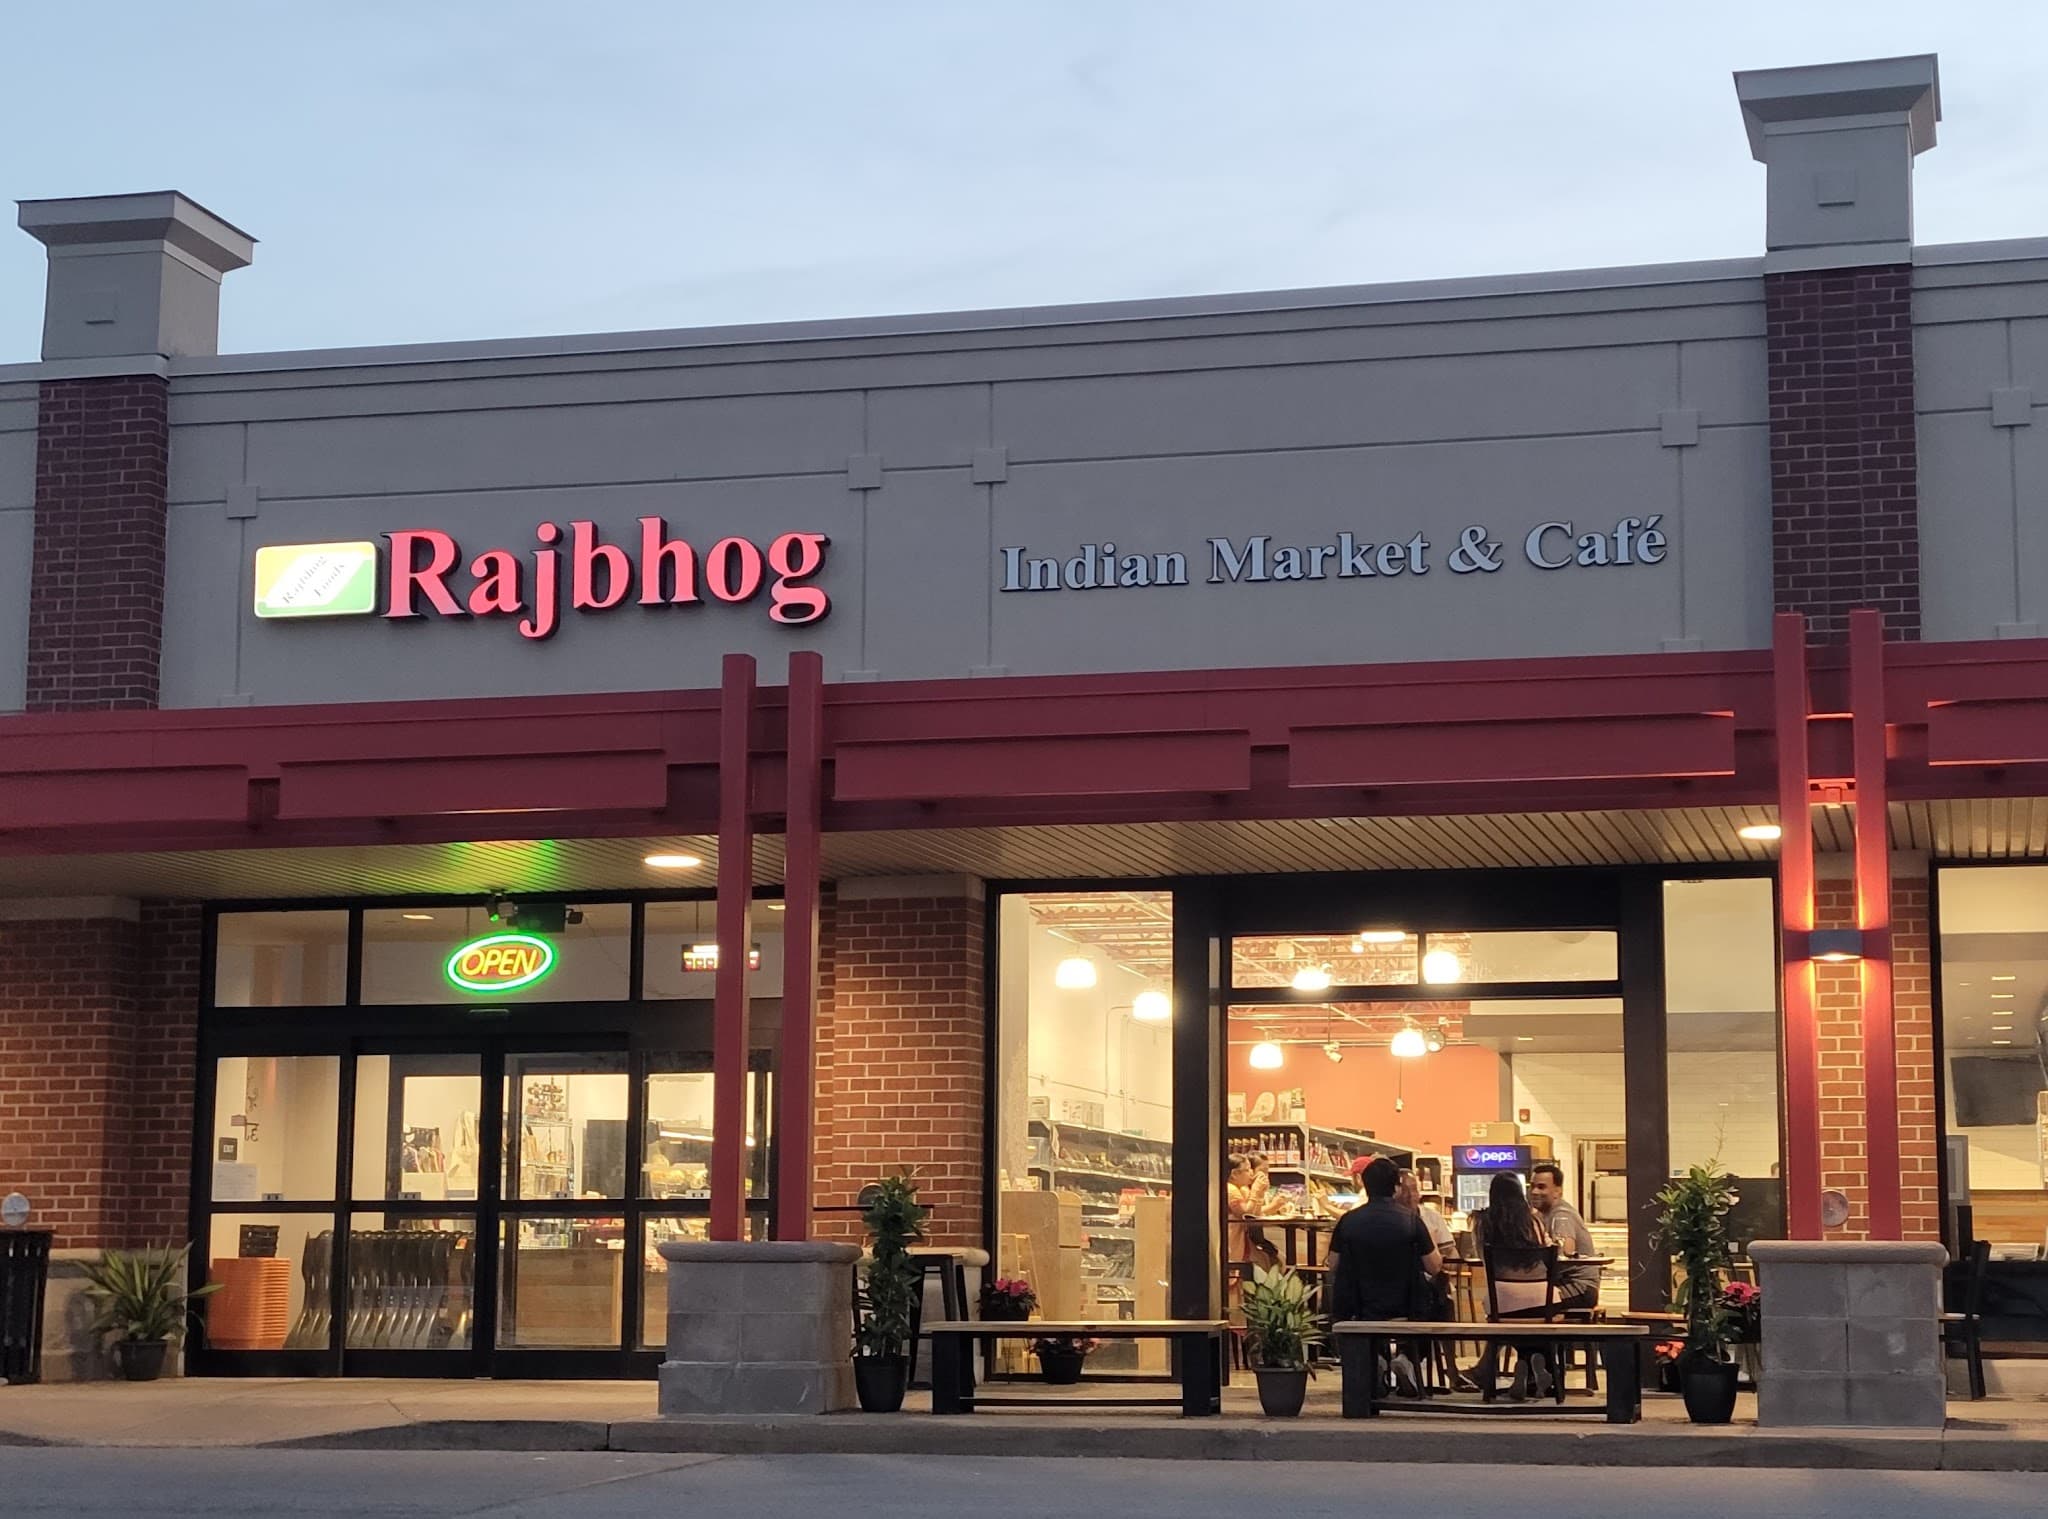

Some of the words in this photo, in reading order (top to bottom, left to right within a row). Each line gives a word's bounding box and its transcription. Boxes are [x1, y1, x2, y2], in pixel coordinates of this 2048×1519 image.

[381, 515, 831, 640] Rajbhog
[1001, 542, 1189, 591] Indian
[1207, 531, 1431, 582] Market
[1447, 524, 1503, 574] &
[1524, 514, 1668, 570] Café
[461, 948, 538, 976] OPEN
[1481, 1149, 1518, 1163] pepsi
